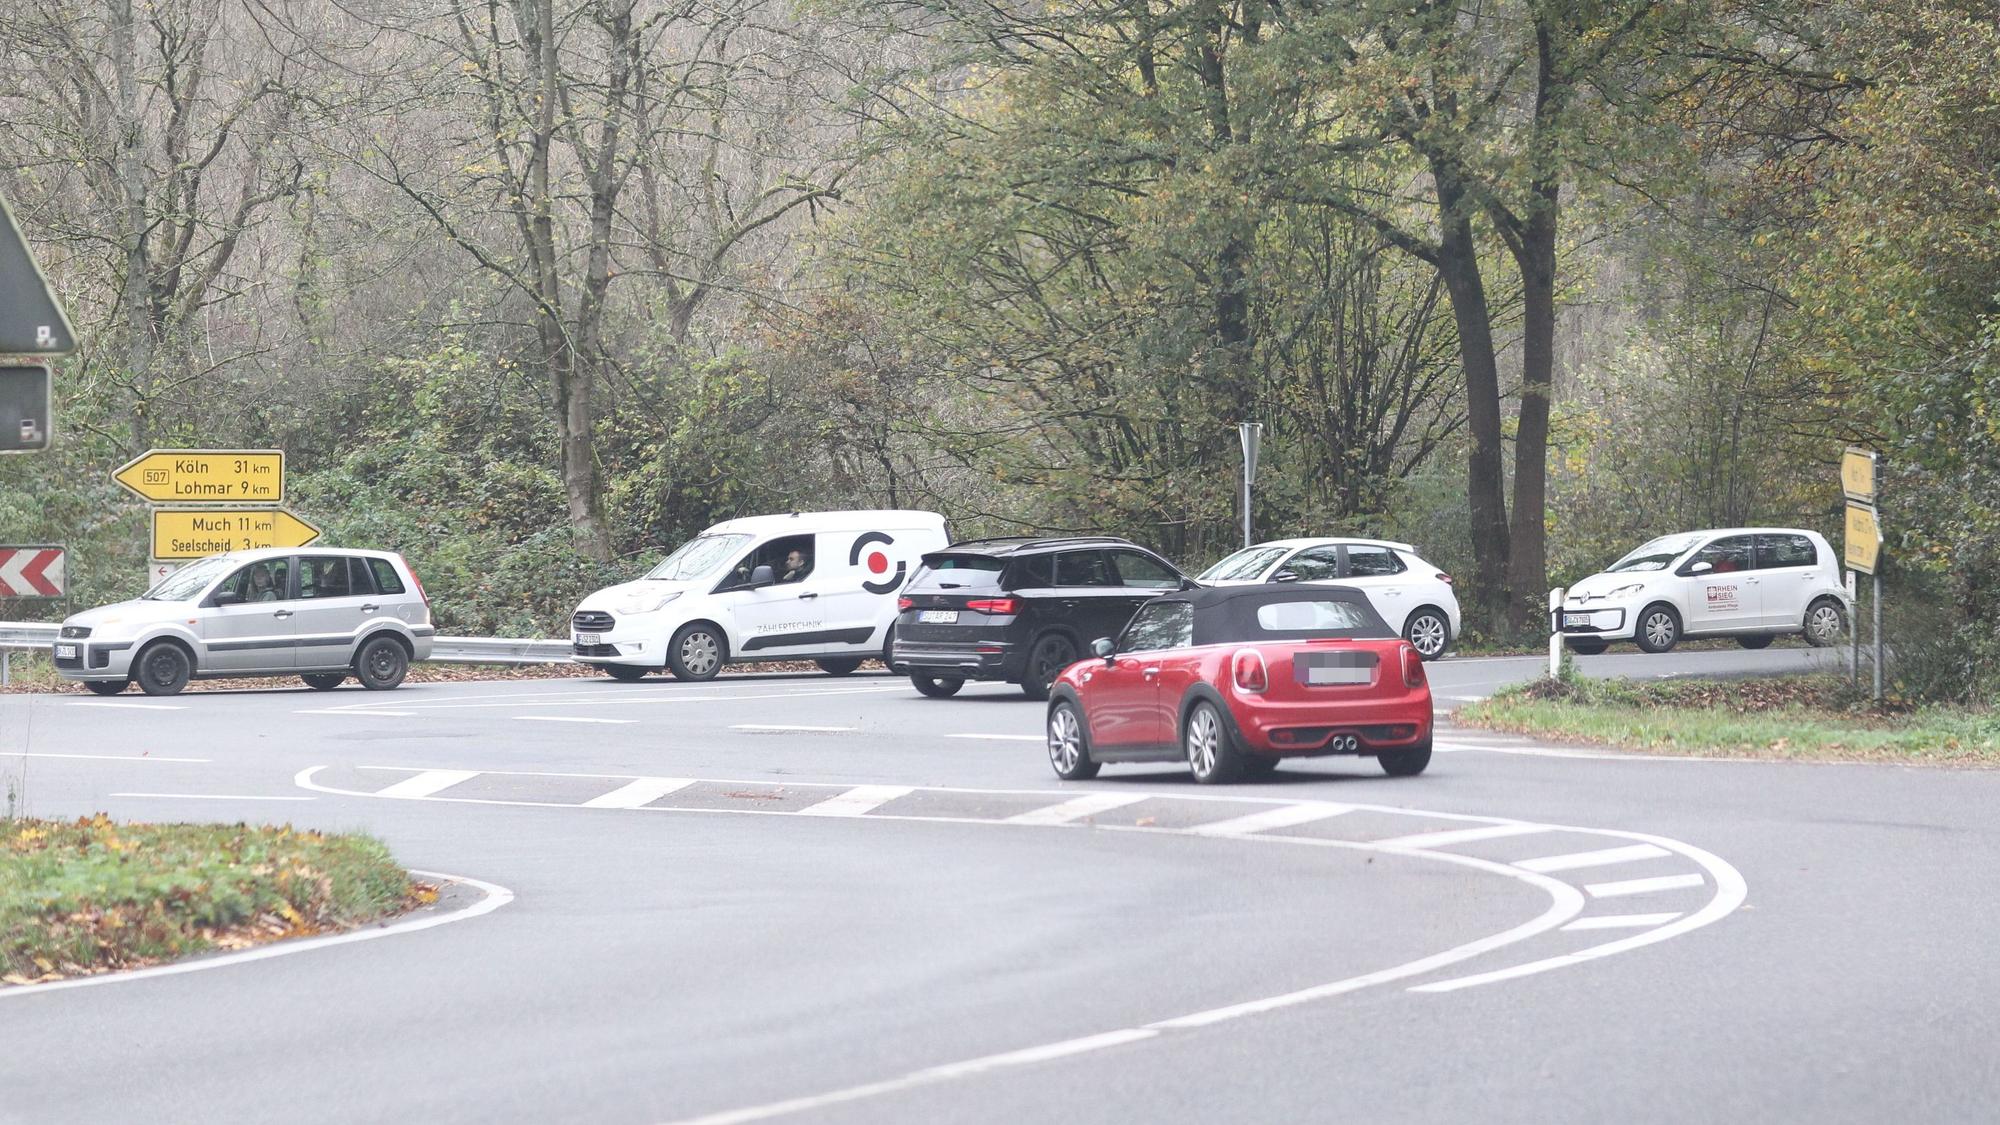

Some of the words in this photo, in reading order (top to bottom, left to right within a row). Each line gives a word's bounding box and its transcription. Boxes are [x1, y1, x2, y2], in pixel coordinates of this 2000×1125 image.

[175, 460, 209, 474] Köln
[234, 460, 248, 474] 31
[253, 463, 270, 474] km
[146, 472, 166, 482] 507
[175, 481, 233, 495] Lohmar
[241, 481, 249, 495] 9
[252, 484, 270, 495] km
[192, 518, 231, 531] Much
[238, 518, 250, 531] 11
[255, 520, 272, 531] km
[171, 538, 231, 552] Seelscheid
[242, 538, 251, 550] 3
